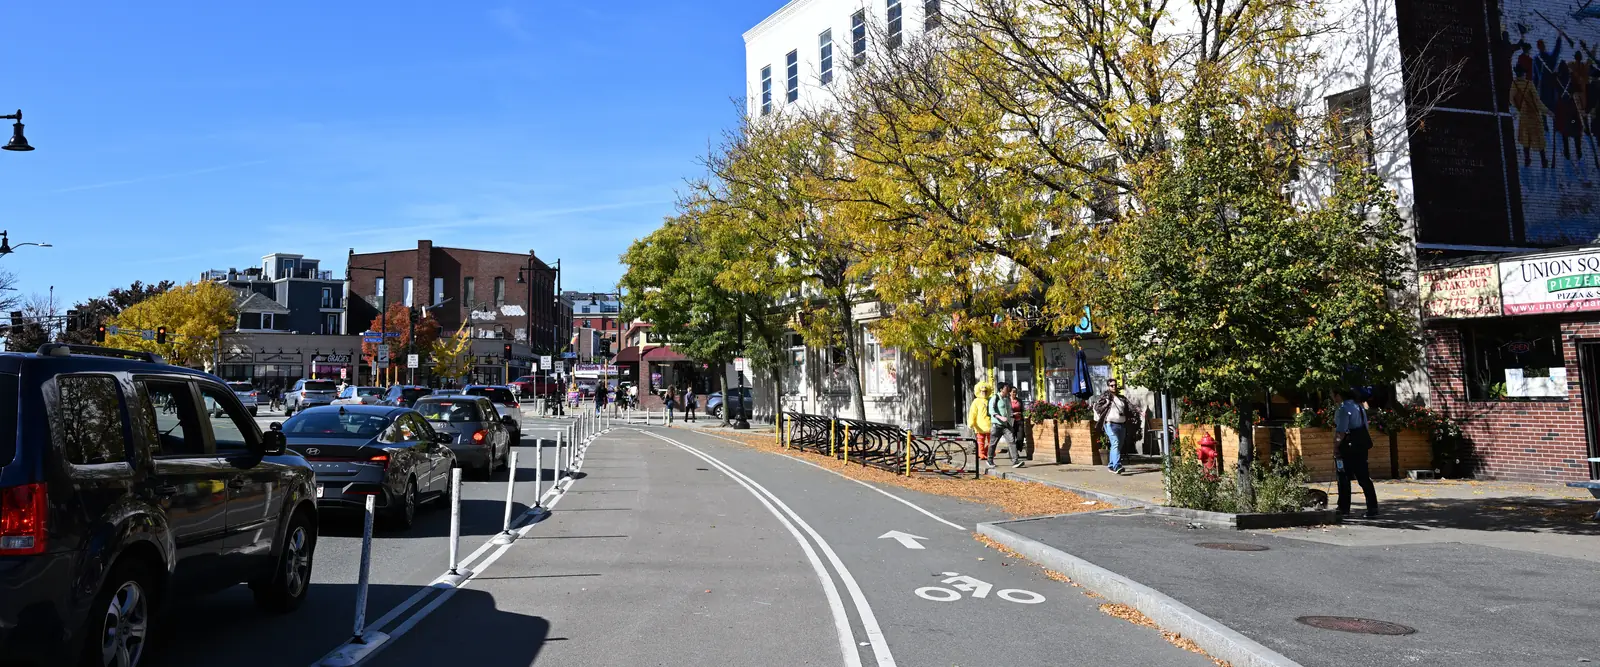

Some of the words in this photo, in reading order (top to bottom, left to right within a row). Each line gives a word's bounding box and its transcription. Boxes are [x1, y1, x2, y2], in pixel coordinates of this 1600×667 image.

[1423, 271, 1446, 282] FREE
[1447, 267, 1493, 280] DELIVERY
[1521, 259, 1573, 283] UNION
[1430, 283, 1442, 291] OR
[1444, 279, 1488, 291] TAKE-OUT
[1424, 295, 1498, 310] 617-776-7617
[1557, 291, 1584, 300] PIZZA
